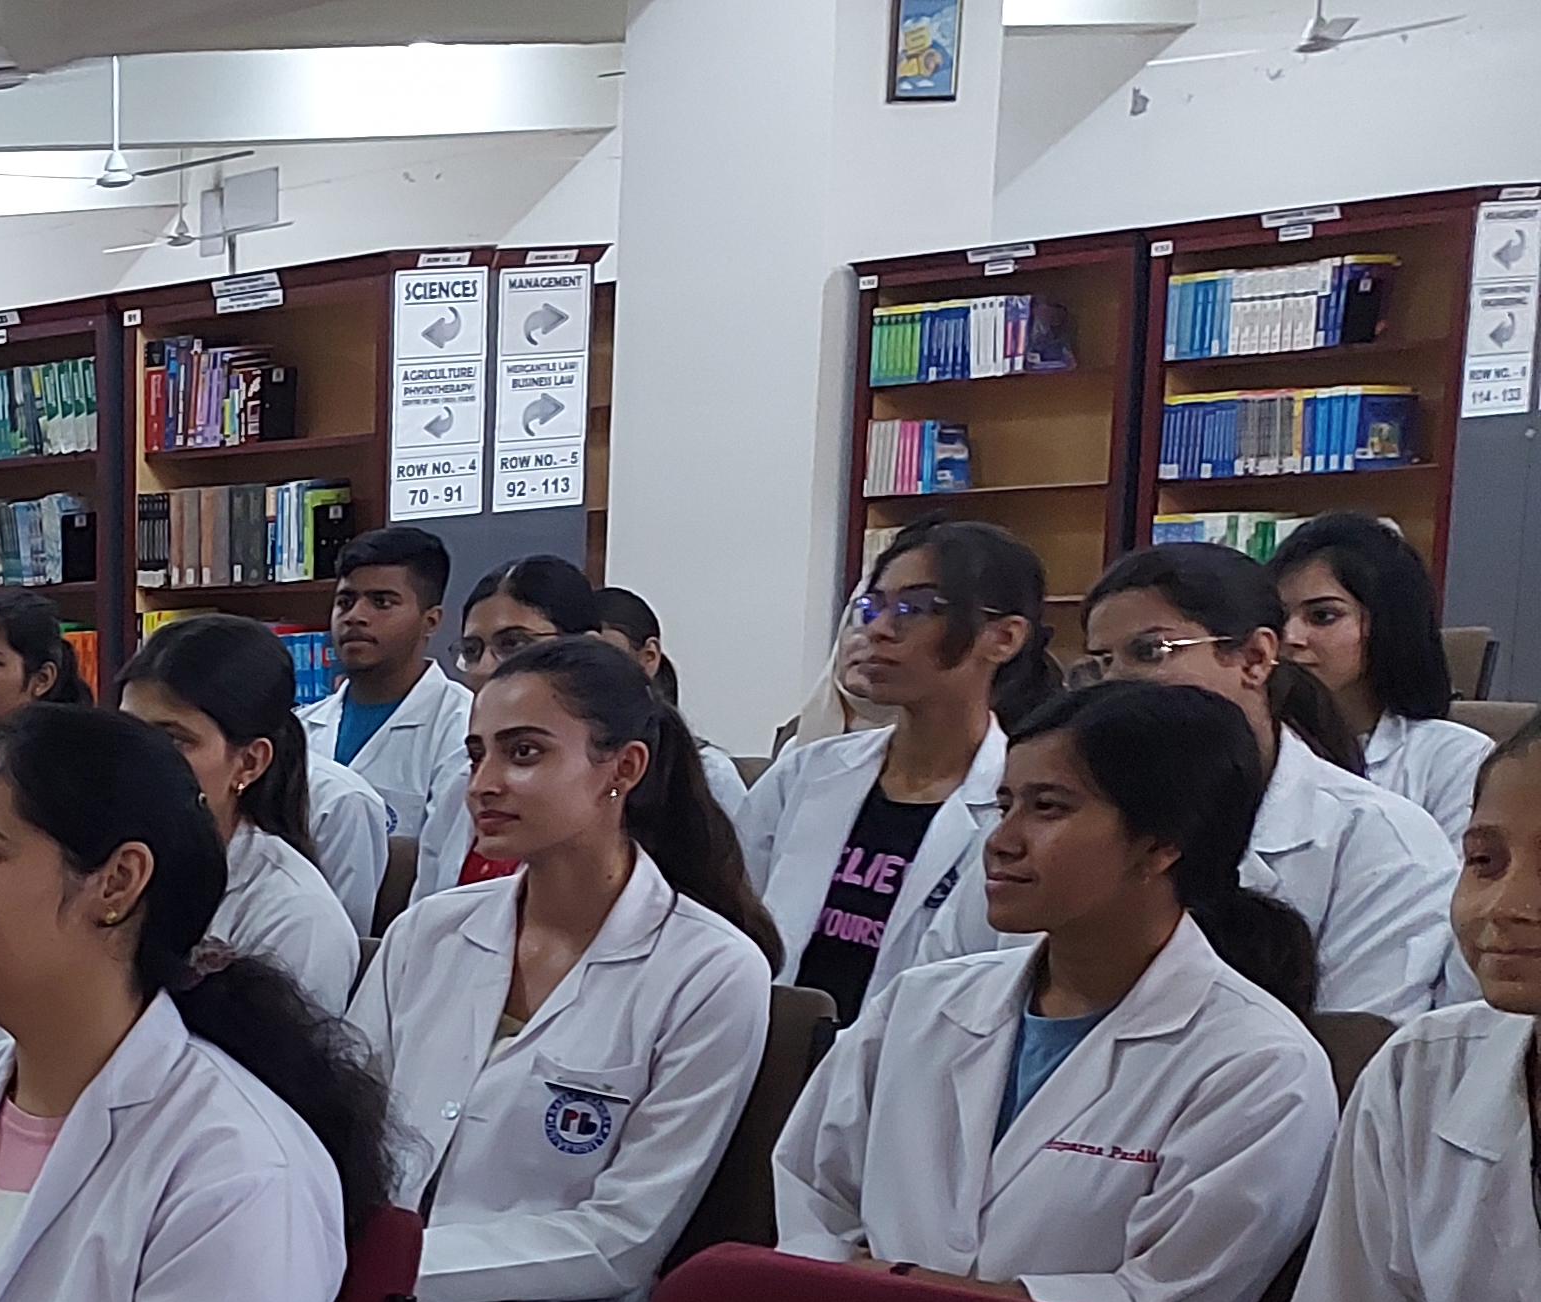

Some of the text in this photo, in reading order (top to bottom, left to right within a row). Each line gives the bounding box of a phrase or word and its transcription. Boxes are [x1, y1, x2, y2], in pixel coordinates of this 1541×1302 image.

[404, 279, 479, 300] SCIENCES
[508, 275, 583, 290] MANAGEMENT
[397, 464, 428, 478] ROW
[432, 461, 455, 476] NO.
[467, 459, 477, 472] 4
[500, 456, 531, 470] ROW
[534, 453, 558, 468] NO.
[570, 451, 579, 464] 5
[408, 488, 429, 506] 70
[444, 485, 463, 502] 91
[506, 481, 527, 498] 92
[541, 477, 571, 495] 113
[833, 846, 908, 894] LIE
